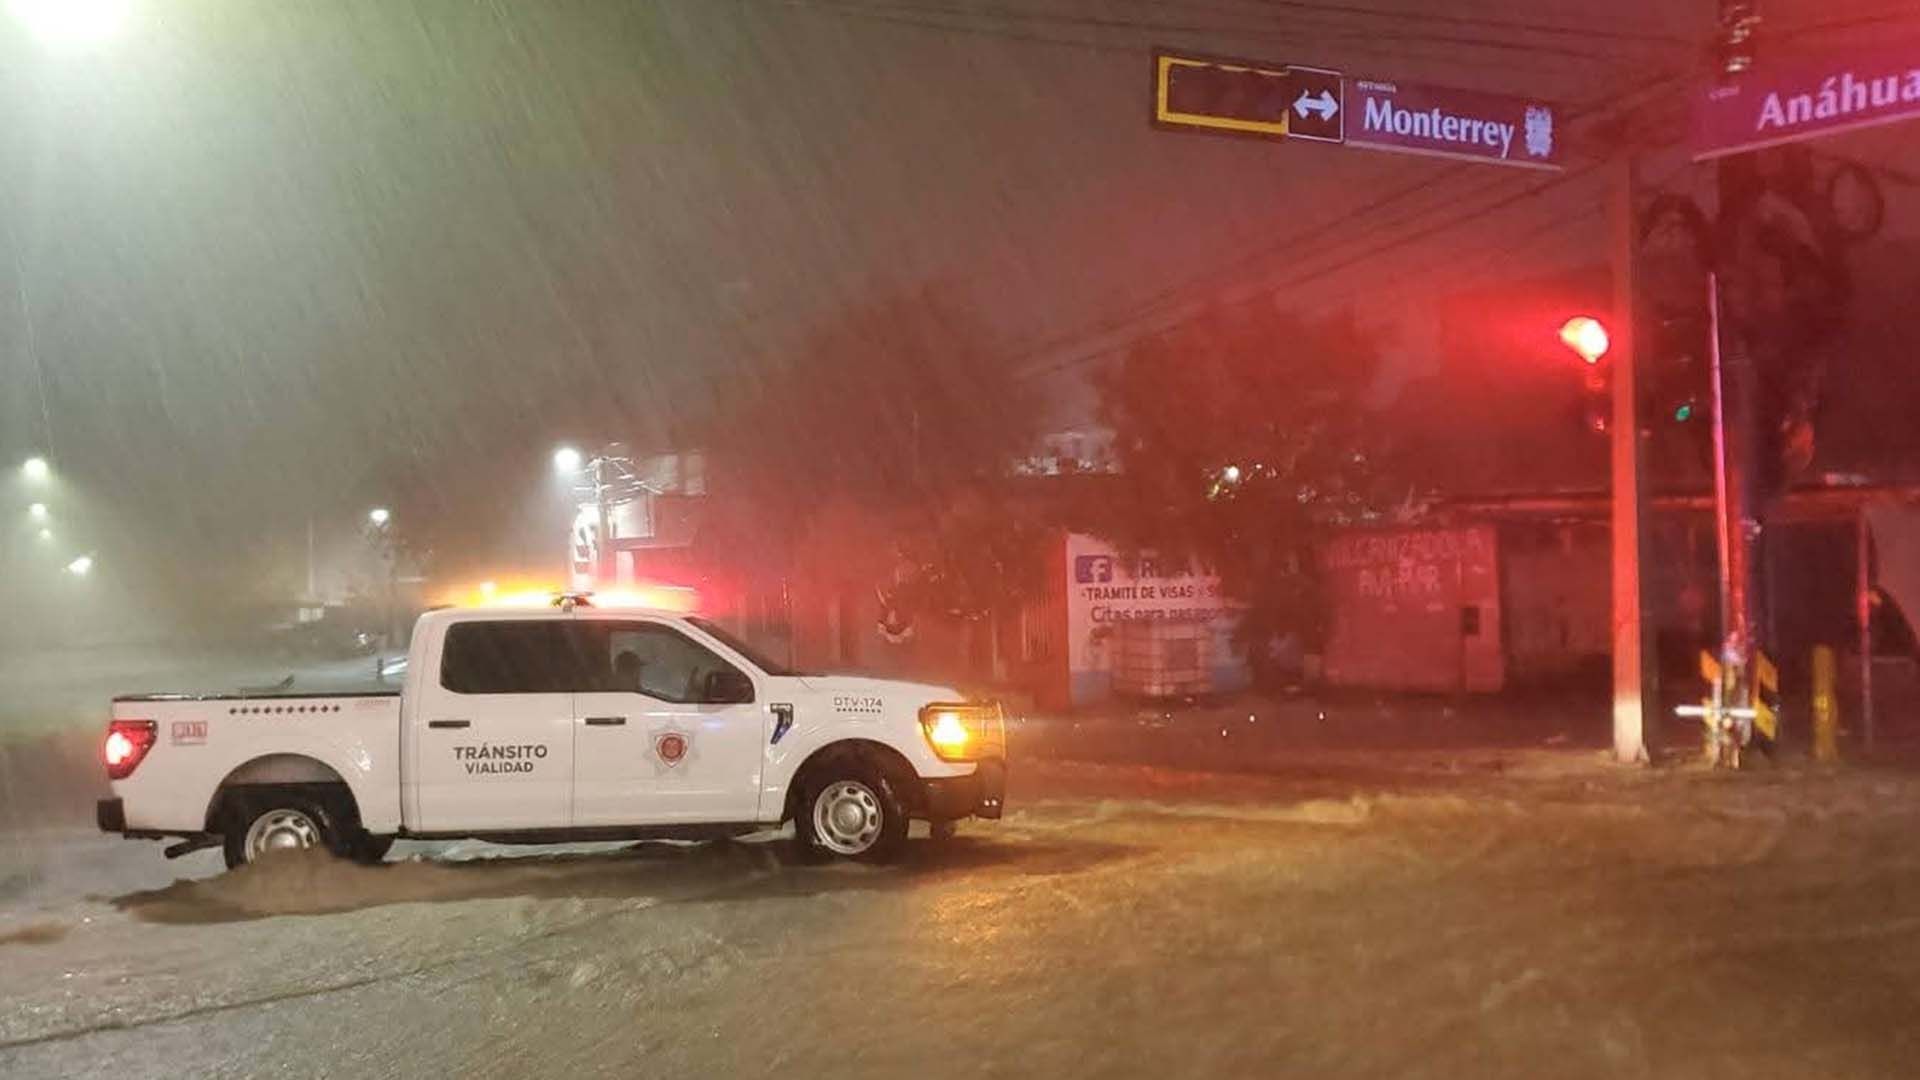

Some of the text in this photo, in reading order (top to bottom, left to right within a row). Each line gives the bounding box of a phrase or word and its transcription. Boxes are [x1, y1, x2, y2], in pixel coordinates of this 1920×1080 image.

[1364, 97, 1515, 159] Monterrey
[1141, 586, 1155, 599] DE
[1159, 585, 1194, 599] VISAS
[833, 696, 883, 708] DTV-174
[454, 743, 548, 760] TRÁNSITO
[465, 761, 534, 774] VIALIDAD
